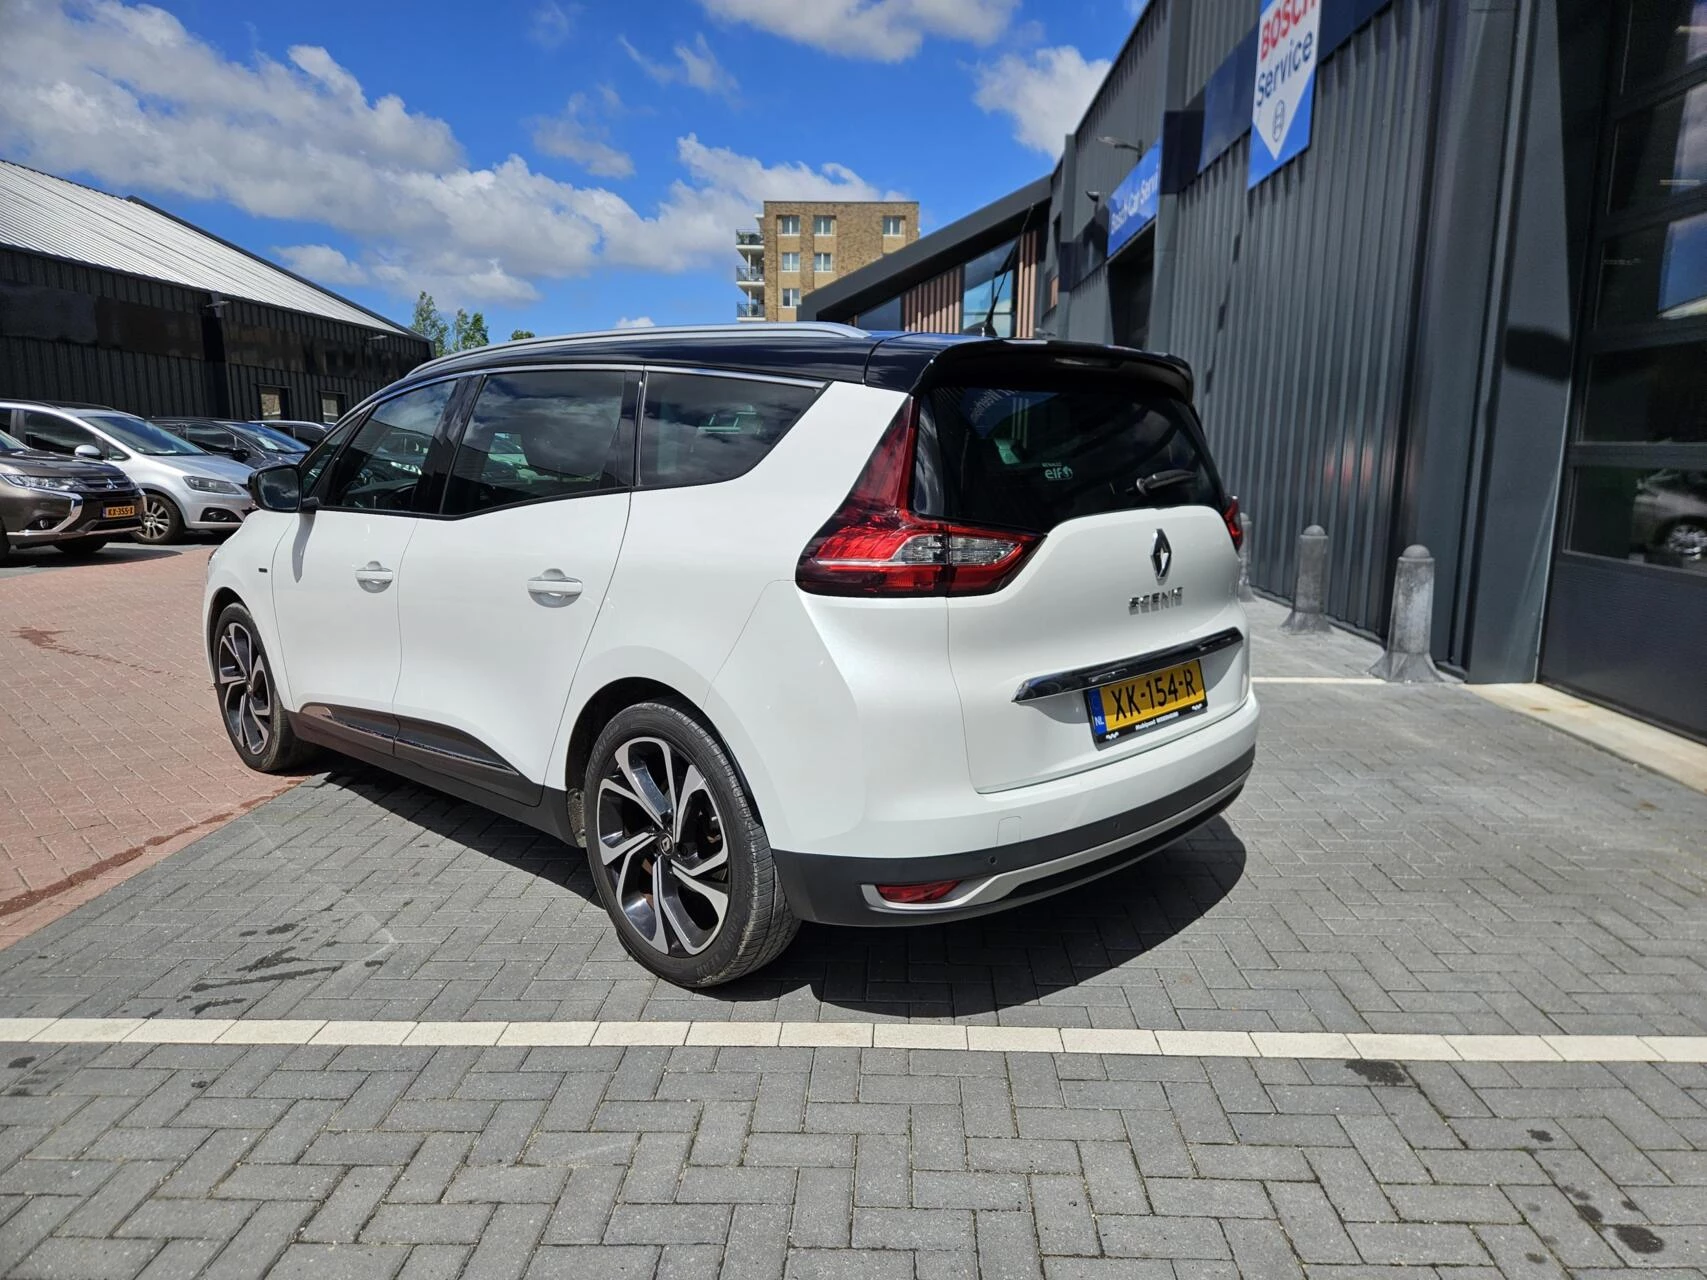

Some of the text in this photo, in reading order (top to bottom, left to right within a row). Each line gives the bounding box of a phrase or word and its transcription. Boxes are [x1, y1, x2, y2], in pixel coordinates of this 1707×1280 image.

[1256, 31, 1313, 107] Service
[1094, 715, 1105, 727] NL
[1112, 670, 1196, 721] XK-154-R
